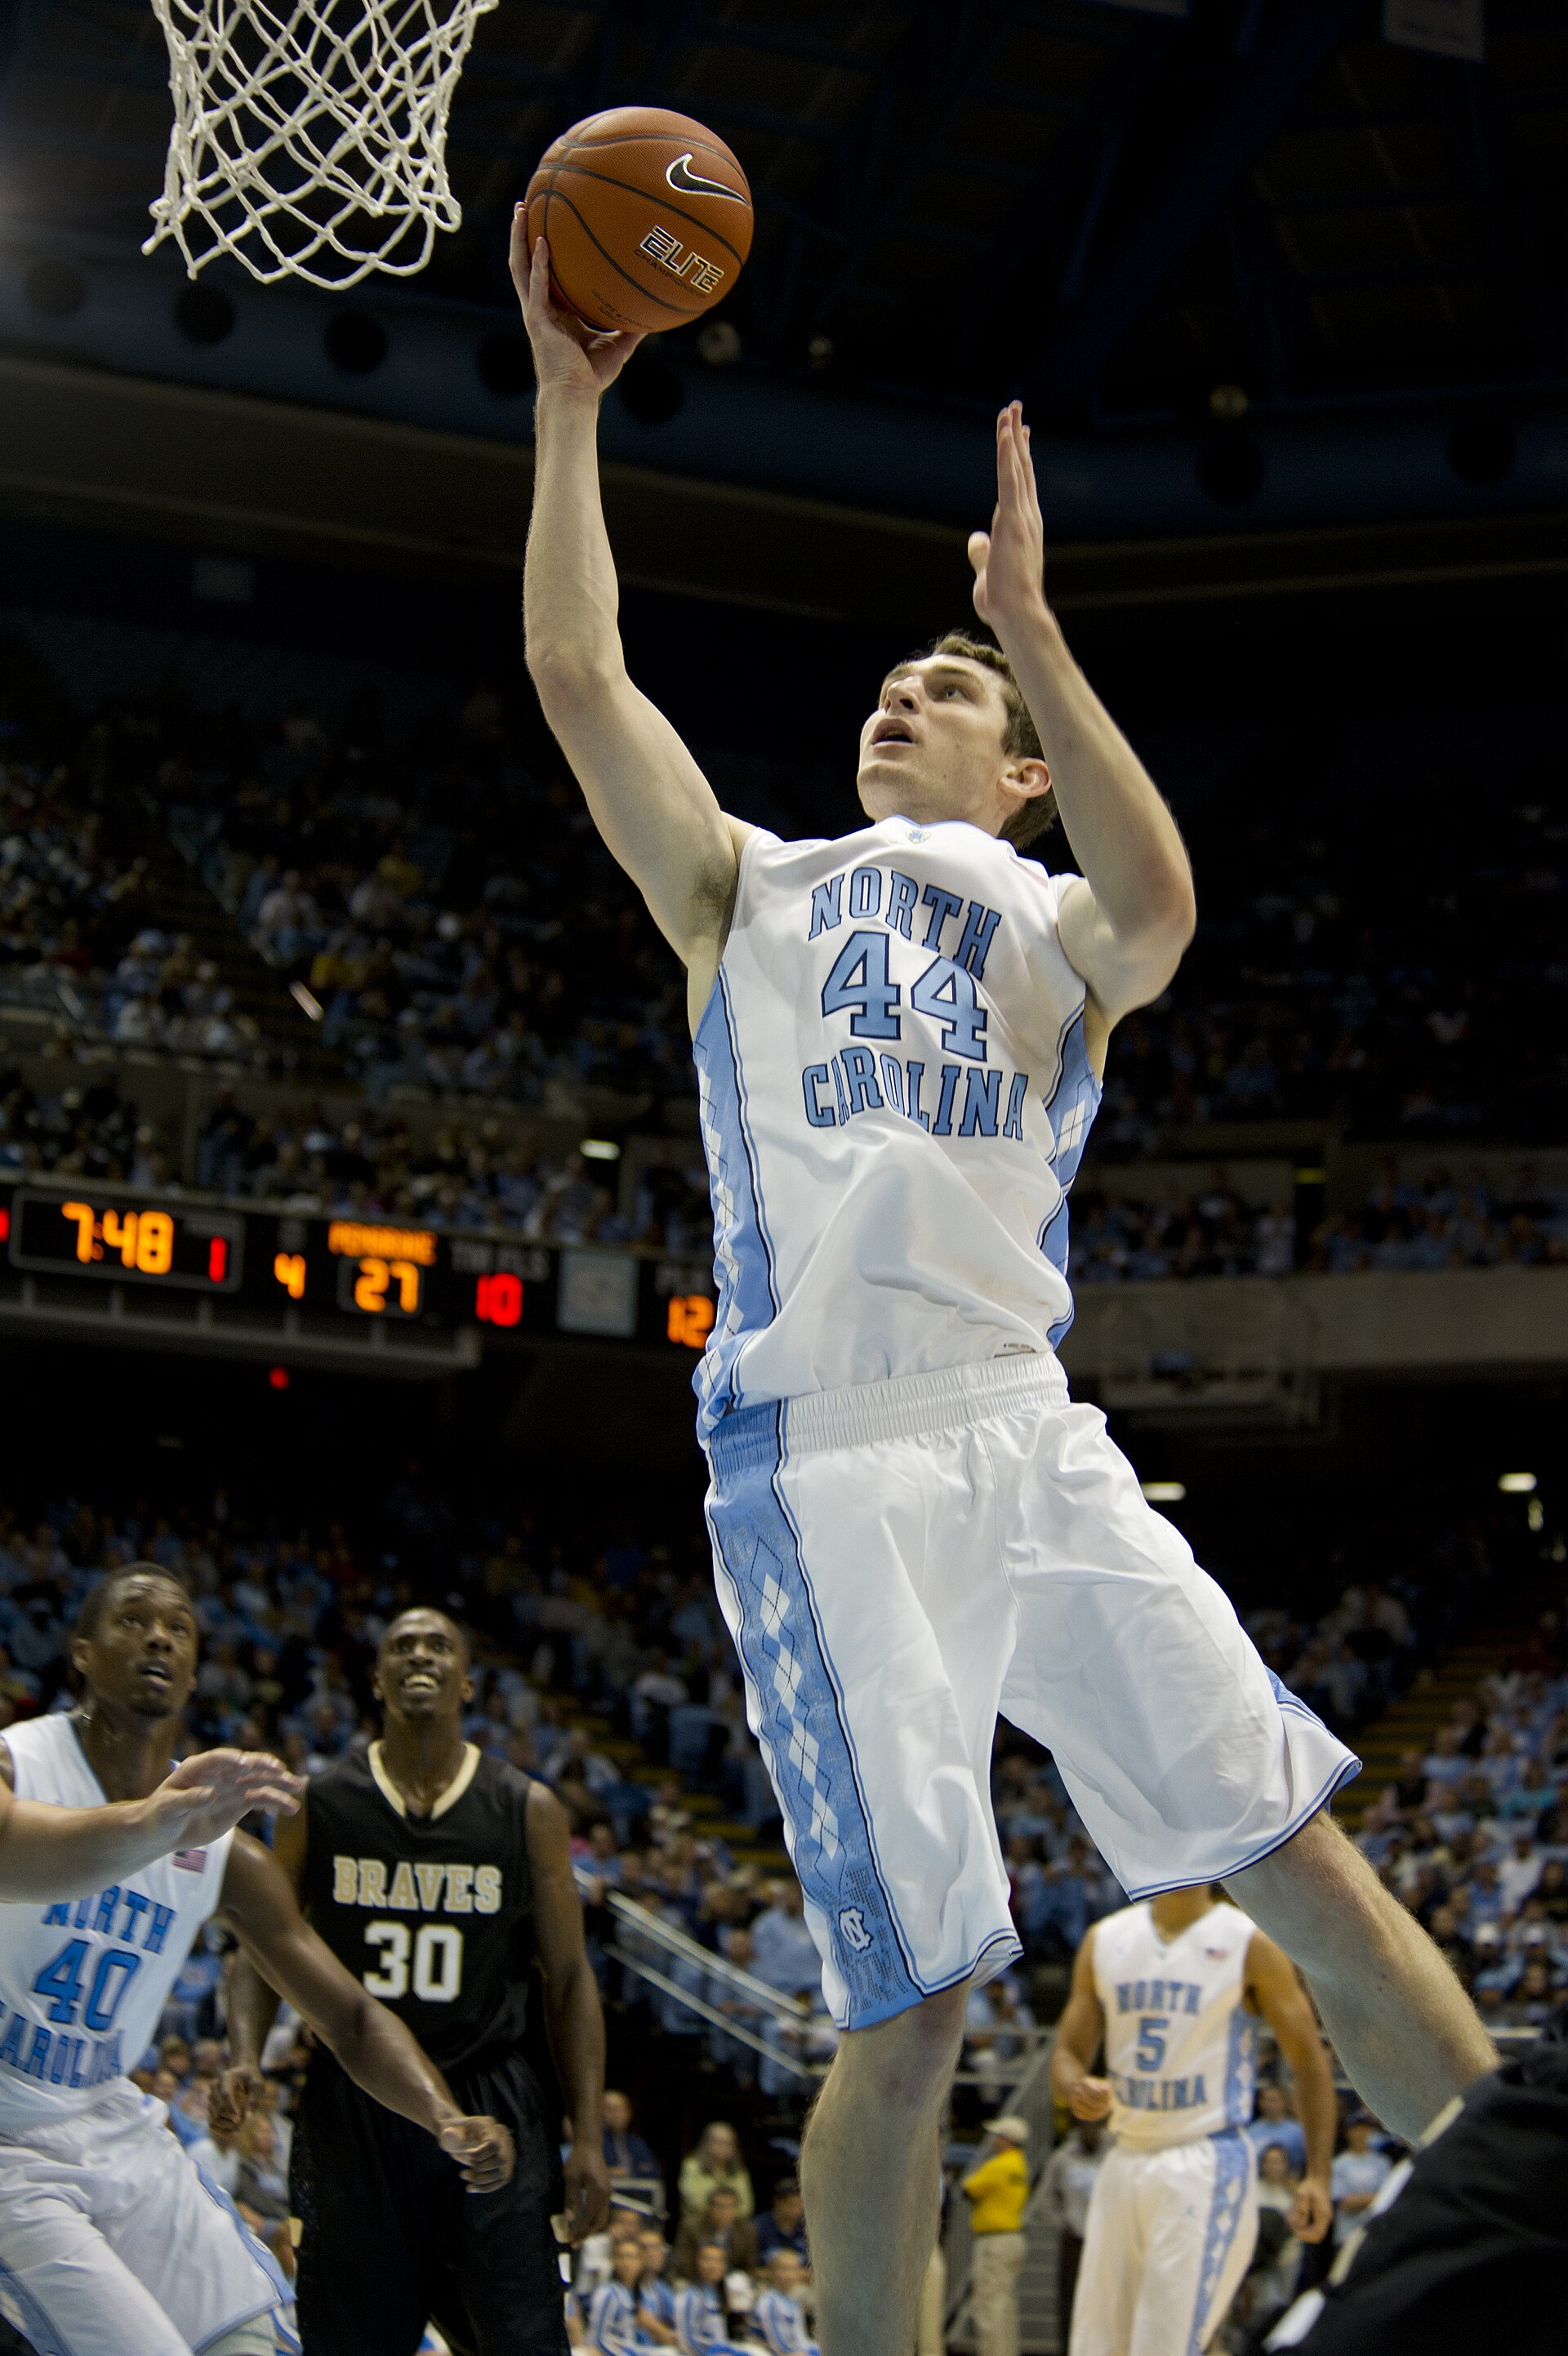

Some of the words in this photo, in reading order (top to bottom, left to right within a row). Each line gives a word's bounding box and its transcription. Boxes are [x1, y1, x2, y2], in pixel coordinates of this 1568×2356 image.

[639, 225, 724, 293] ELITE
[808, 866, 1002, 980] NORTH
[821, 931, 988, 1062] 44
[802, 1046, 1029, 1142] CAROLINA
[61, 1201, 174, 1275] 7:48
[274, 1252, 306, 1298] 4
[354, 1258, 420, 1312] 27
[476, 1272, 523, 1327] 10
[332, 1855, 502, 1914] BRAVES
[34, 1937, 142, 2031] 40
[363, 1920, 463, 2002] 30
[1136, 2017, 1169, 2072] 5
